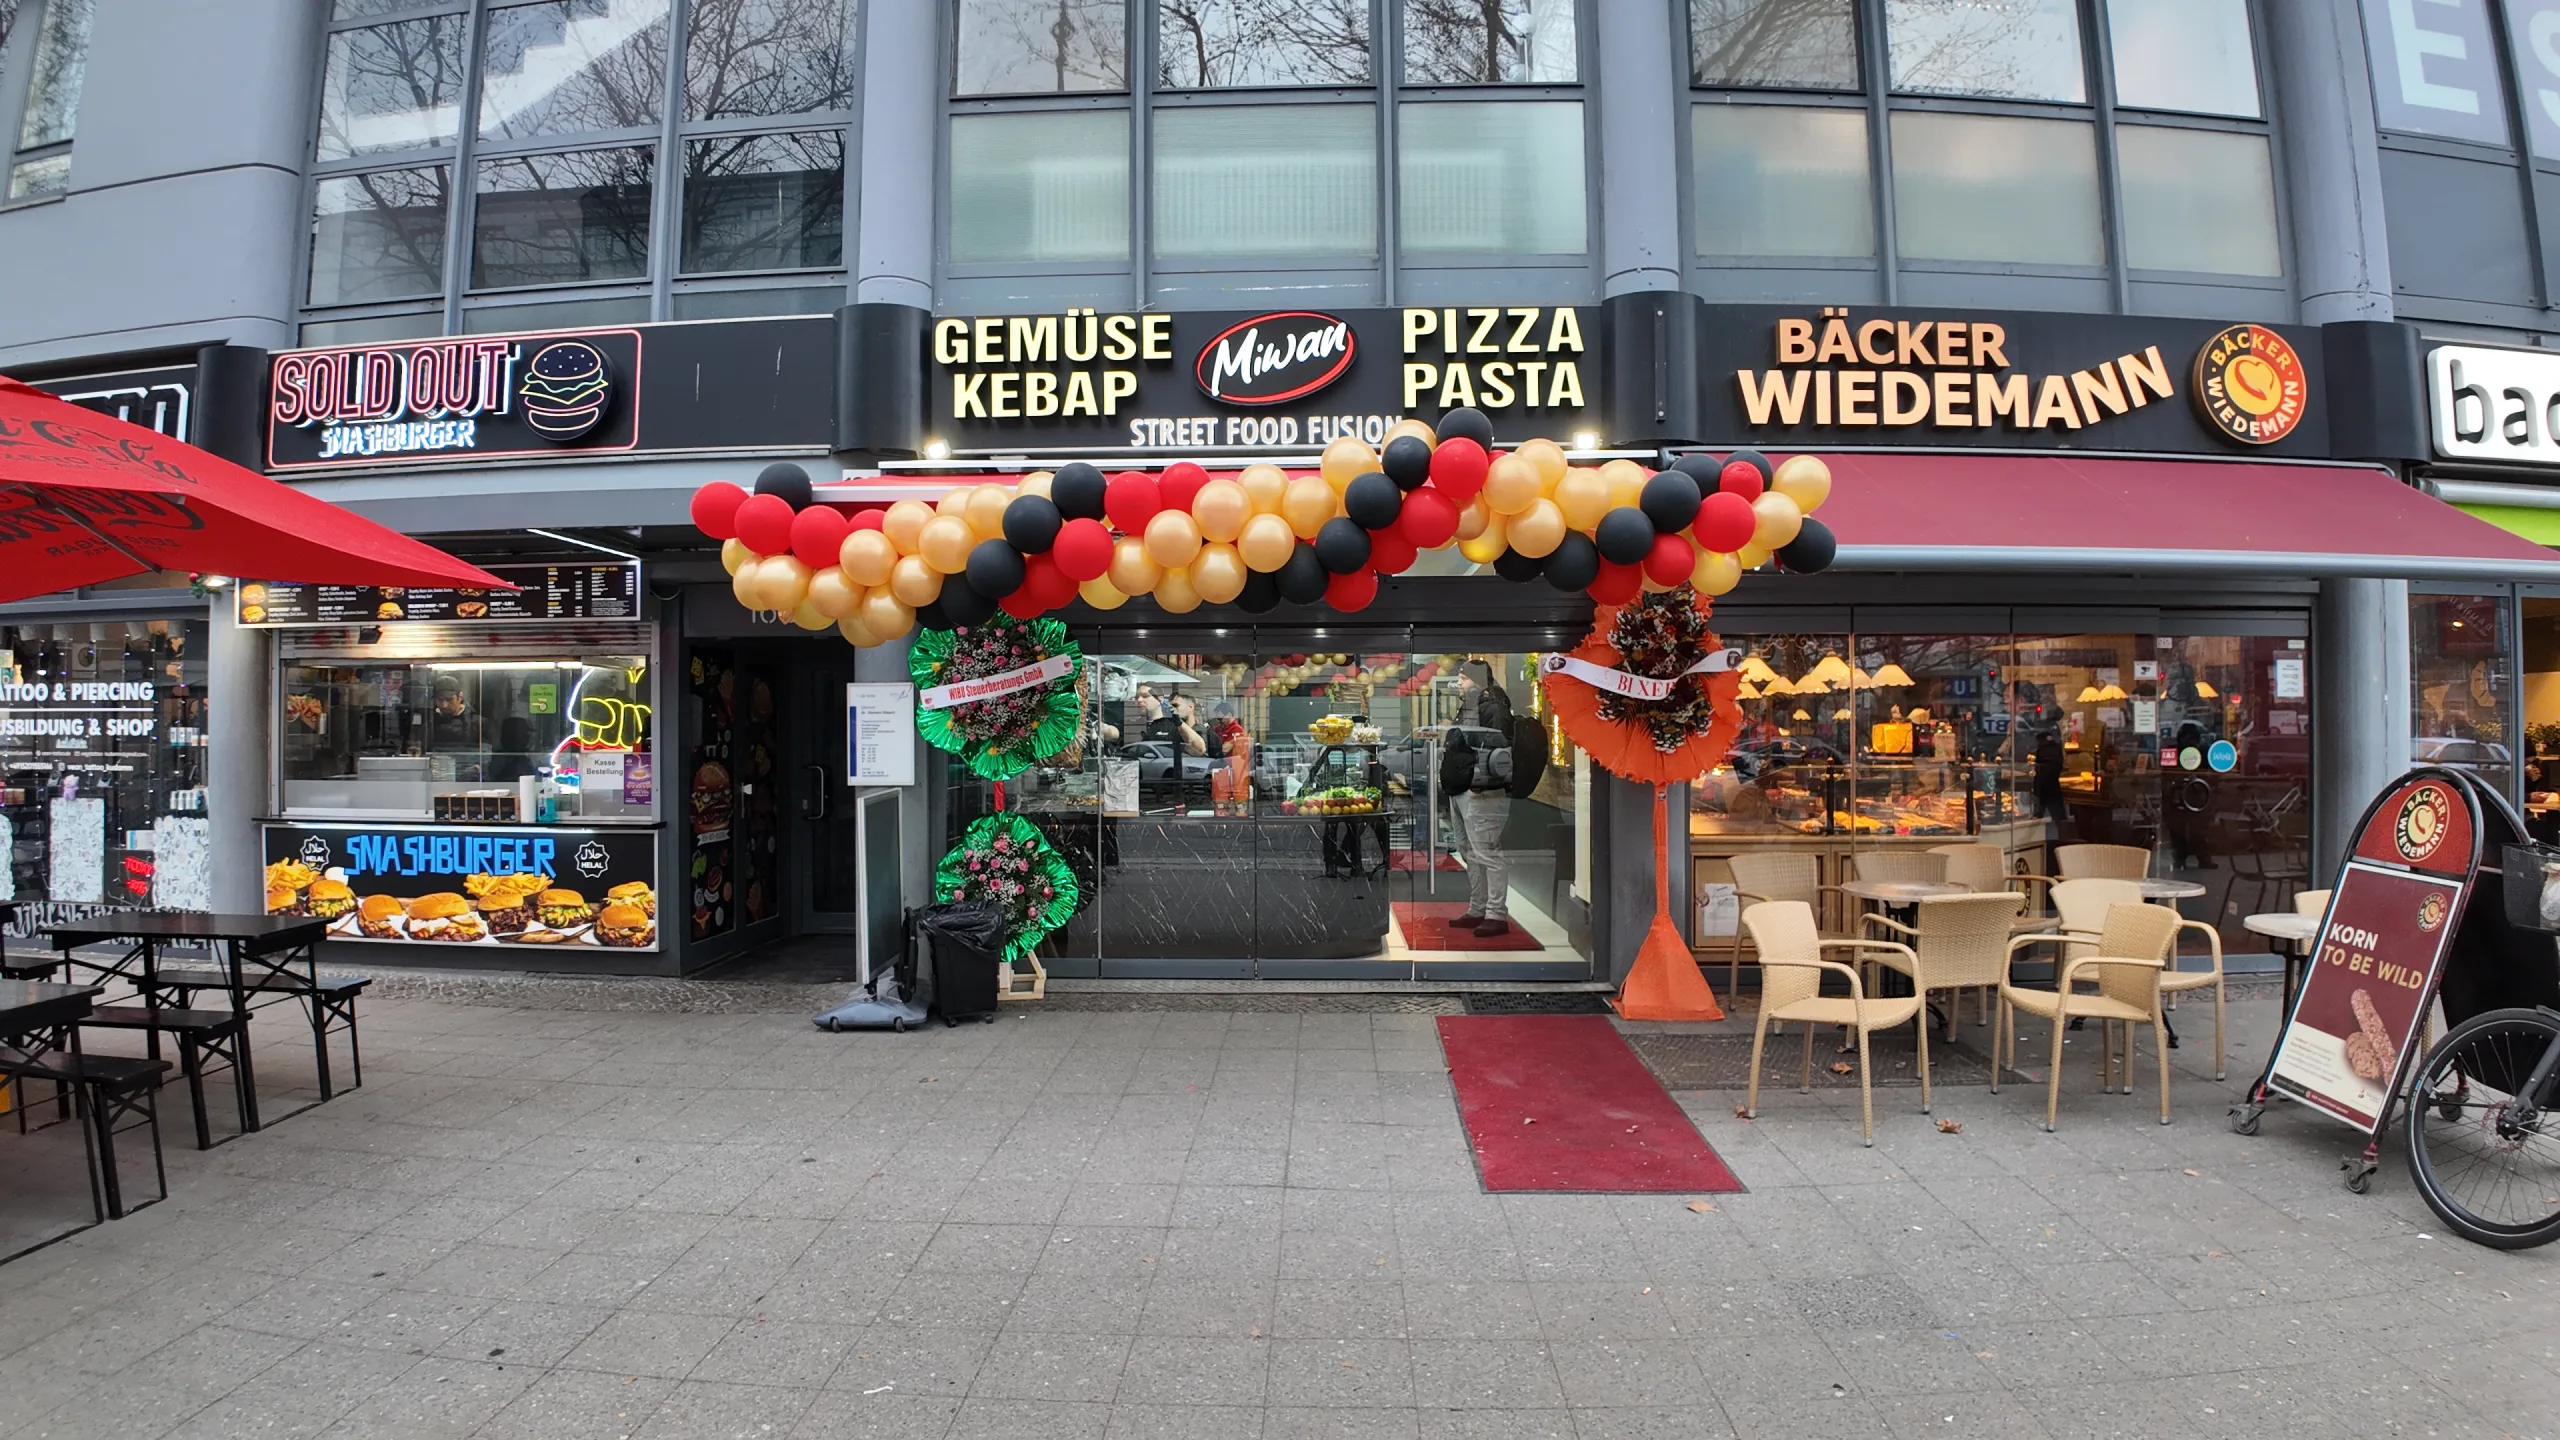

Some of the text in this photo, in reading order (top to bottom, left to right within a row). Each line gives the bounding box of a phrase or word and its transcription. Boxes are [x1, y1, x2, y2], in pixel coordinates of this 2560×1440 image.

[933, 307, 1173, 364] GEMÜSE
[1402, 307, 1585, 355] PIZZA
[1777, 306, 2010, 368] BÄCKER
[2210, 332, 2292, 371] BÄCKER
[1211, 322, 1347, 397] Miwan
[275, 350, 402, 425] SOLD
[408, 341, 515, 415] OUT
[952, 369, 1138, 419] KEBAP
[1402, 360, 1585, 408] PASTA
[1736, 345, 2174, 429] WIEDEMANN
[2207, 376, 2299, 437] WIEDEMANN
[318, 420, 475, 458] SMASHBURGER
[1129, 417, 1219, 446] STREET
[1226, 416, 1299, 445] FOOD
[53, 682, 67, 702] &
[71, 682, 154, 702] PIERCING
[948, 666, 1044, 700] WIBU Steuerberatungs GmbH
[88, 718, 102, 737] &
[106, 718, 154, 737] SHOP
[586, 768, 624, 776] Bestellung
[594, 759, 616, 767] Kasse
[2406, 789, 2447, 818] BÄCKER
[344, 834, 557, 879] SMASHBURGER
[2398, 817, 2445, 858] WIEDEMANN
[581, 861, 604, 869] HELAL
[2328, 922, 2379, 951] KORN
[2323, 945, 2423, 990] TO BE WILD
